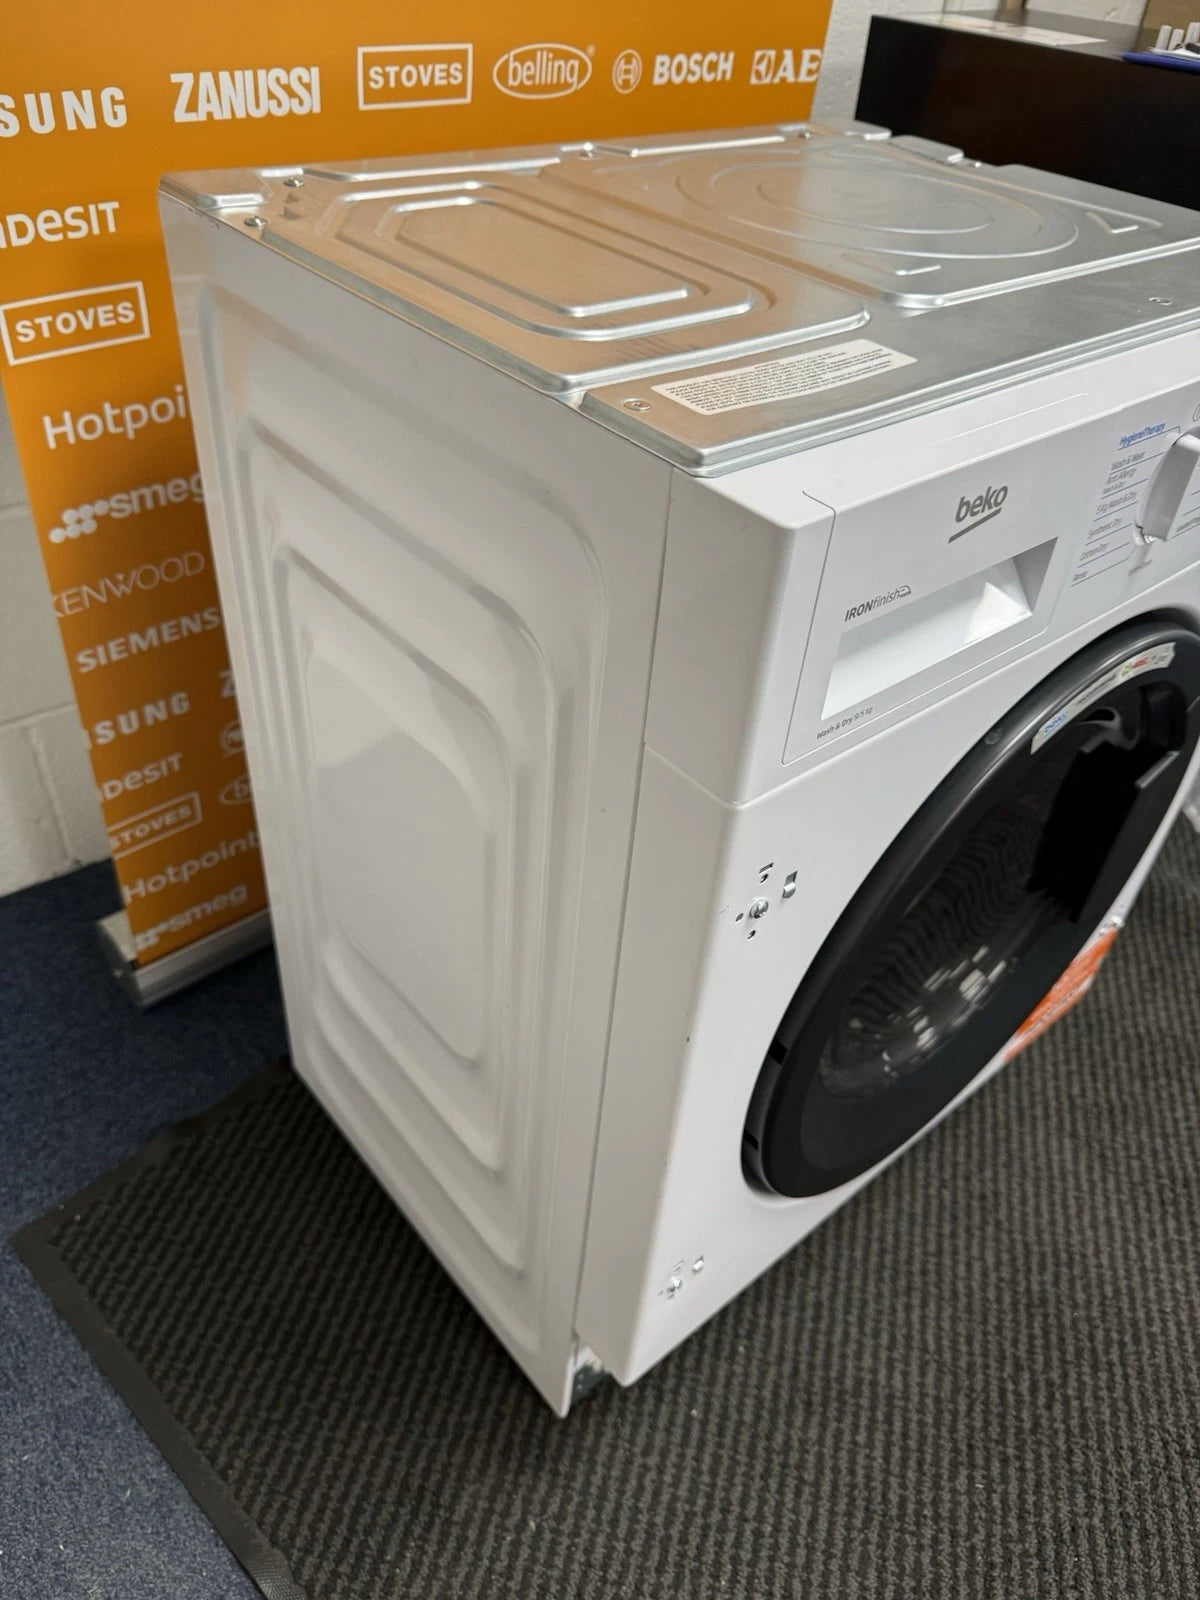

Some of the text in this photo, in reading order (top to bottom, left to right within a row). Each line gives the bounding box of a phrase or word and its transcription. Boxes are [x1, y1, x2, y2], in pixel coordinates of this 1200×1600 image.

[368, 62, 463, 89] STOVES
[507, 50, 579, 91] belling
[652, 51, 735, 86] BOSCH
[0, 86, 128, 138] SUNG
[169, 66, 321, 123] ZANUSSI
[15, 301, 136, 344] STOVES
[41, 384, 188, 451] Hotpoi
[954, 485, 1009, 524] beko
[75, 607, 222, 674] SIEMENS
[93, 690, 191, 746] SUNG
[109, 803, 193, 851] STOVES
[168, 884, 249, 933] smeg
